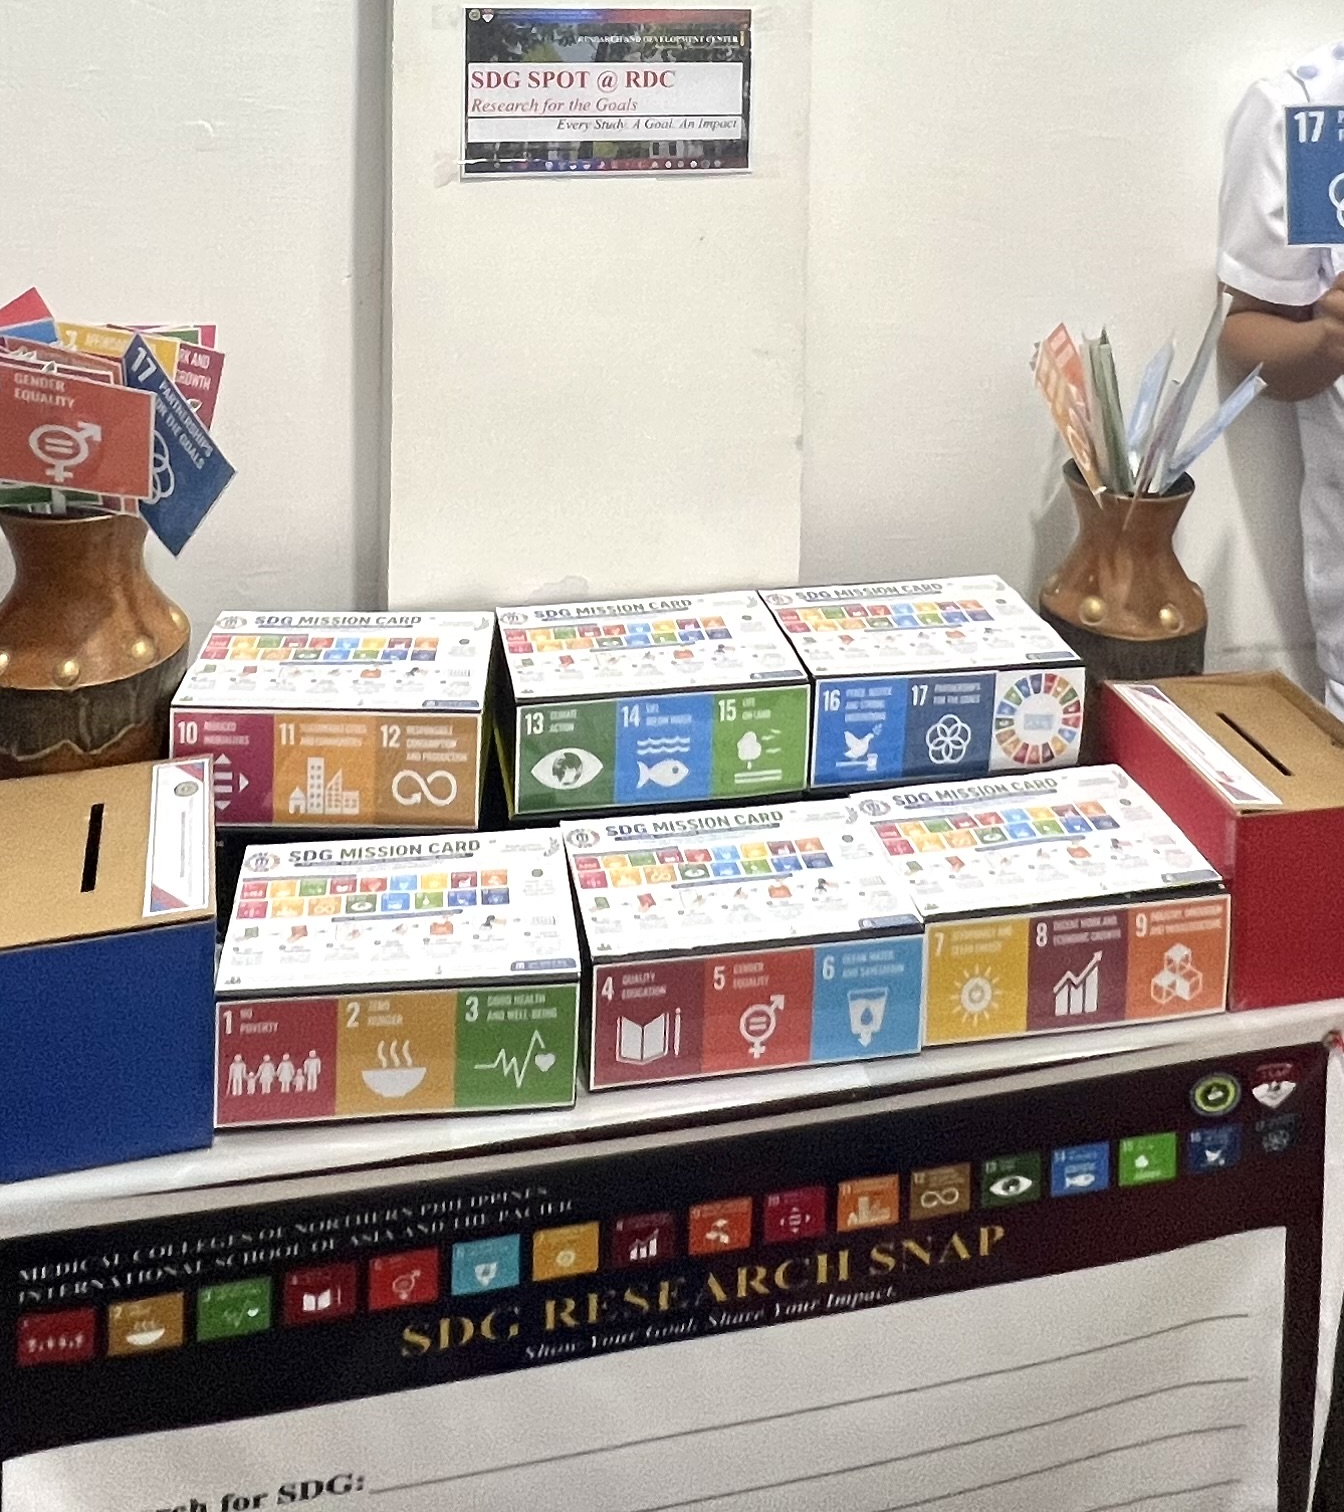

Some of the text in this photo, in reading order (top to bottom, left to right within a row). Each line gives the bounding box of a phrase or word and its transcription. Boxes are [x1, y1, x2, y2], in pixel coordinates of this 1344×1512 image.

[706, 35, 739, 44] CENTER
[471, 70, 676, 93] SDG SPOT @ RDC
[471, 97, 638, 114] Research for the Goals
[556, 119, 590, 132] Every
[632, 119, 641, 129] A
[680, 119, 695, 129] An
[699, 119, 737, 131] Impact
[1293, 110, 1324, 143] 17
[131, 347, 157, 382] 17
[191, 352, 210, 369] AND
[14, 372, 65, 392] GENDER
[14, 388, 75, 409] EQUALITY
[159, 380, 213, 458] PARTNERSHIPS
[179, 434, 205, 470] GOALS
[795, 582, 943, 601] SDG MISSION CARD
[255, 615, 422, 626] SDG MISSION CARD
[534, 598, 692, 619] SDG MISSION CARD
[823, 689, 841, 712] 16
[912, 684, 928, 706] 17
[621, 704, 641, 728] 14
[718, 699, 737, 722] 15
[177, 720, 199, 745] 10
[278, 722, 296, 746] 11
[380, 724, 401, 748] 12
[525, 712, 544, 736] 13
[892, 777, 1058, 806] SDG MISSION CARD
[605, 809, 784, 837] SDG MISSION CARD
[288, 839, 480, 863] SDG MISSION CARD
[1036, 922, 1047, 947] 8
[1135, 913, 1148, 938] 9
[935, 932, 944, 956] 7
[622, 972, 656, 986] QUALITY
[713, 965, 726, 990] 5
[822, 956, 835, 981] 6
[601, 976, 614, 1001] 4
[621, 985, 667, 1000] EDUCATION
[346, 1002, 360, 1029] 2
[465, 996, 479, 1023] 3
[222, 1009, 233, 1035] 1
[239, 1021, 279, 1034] POVERTY
[20, 1187, 548, 1281] MEDICAL COLLEGES OF NORTHERN PHILIPPINES
[19, 1199, 574, 1304] INTERNATIONAL SCHOOL OF ASIA AND THE PACIFIC
[402, 1225, 1006, 1358] SDG RESEARCH SNAP
[525, 1342, 577, 1360] Show
[591, 1331, 635, 1348] Your
[709, 1309, 765, 1328] Share
[774, 1299, 821, 1317] Your
[220, 1492, 269, 1512] for
[276, 1473, 366, 1506] SDG:
